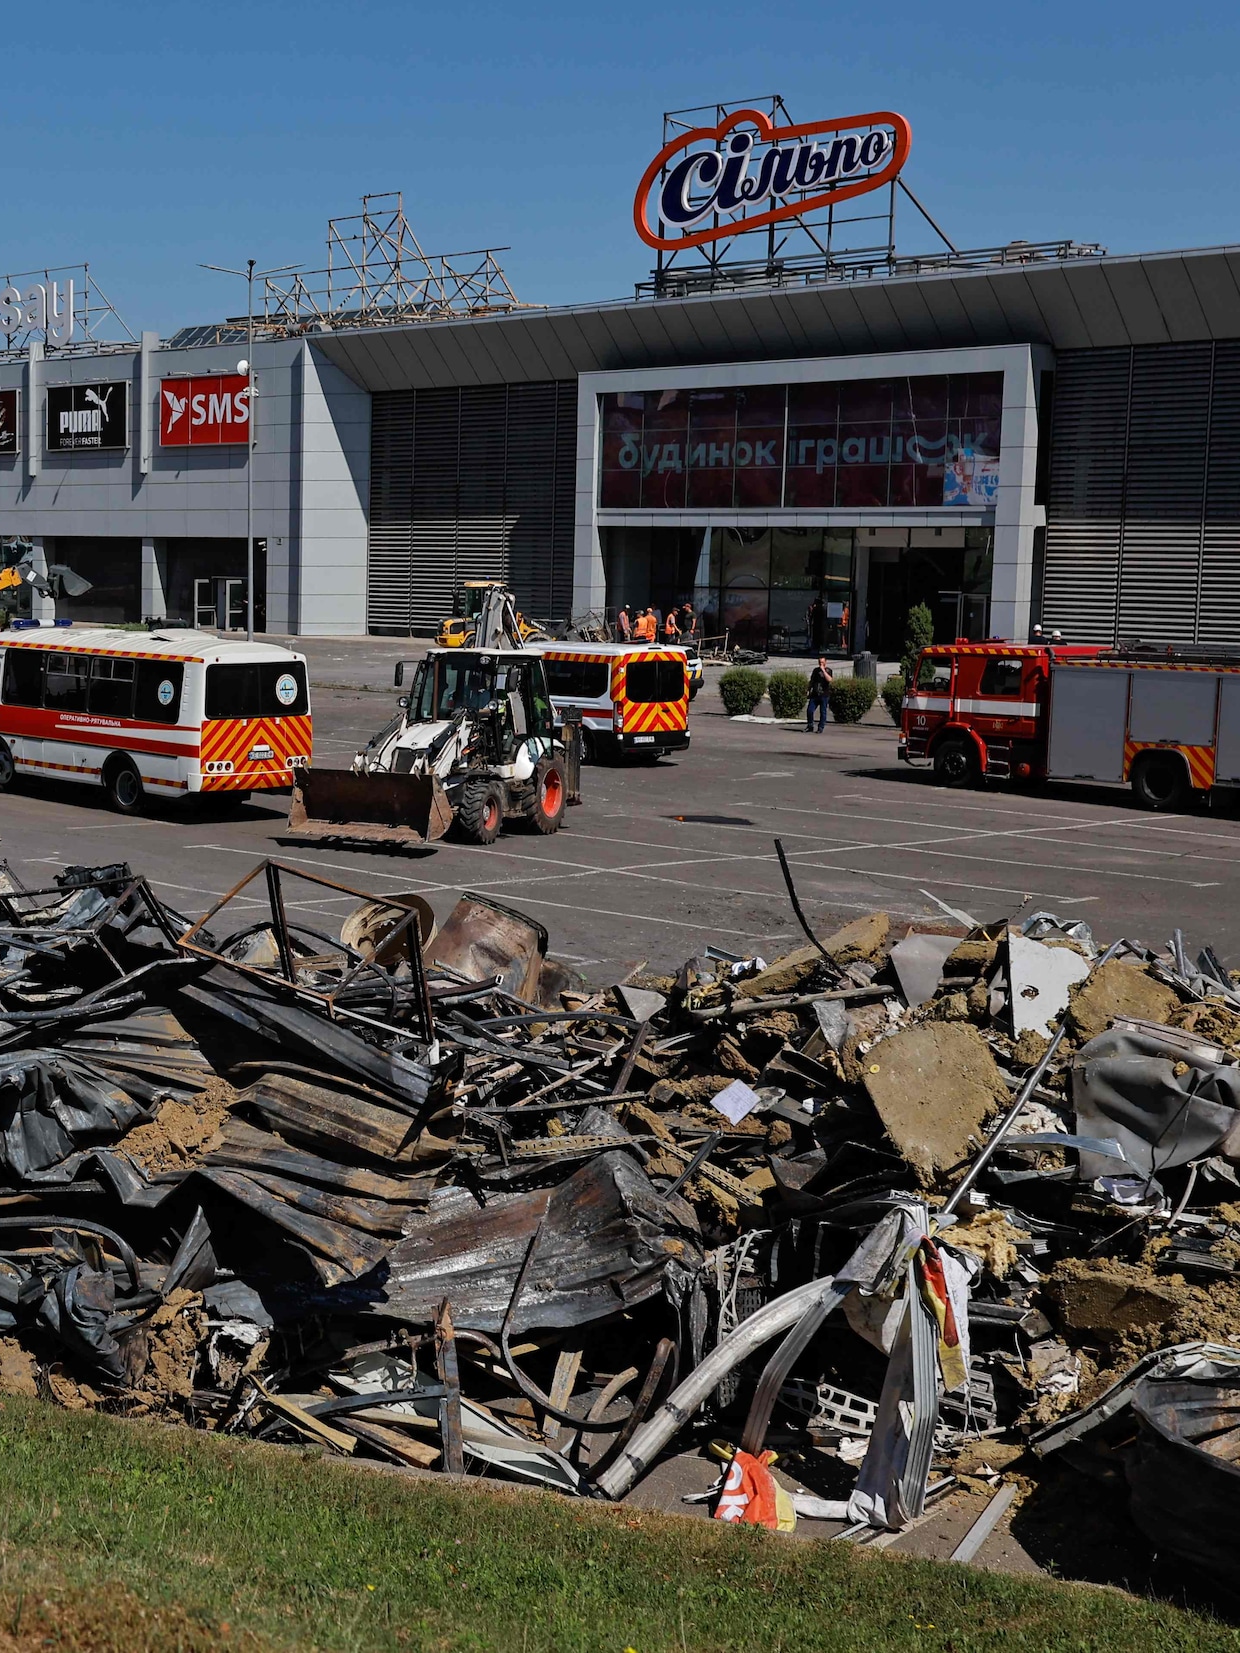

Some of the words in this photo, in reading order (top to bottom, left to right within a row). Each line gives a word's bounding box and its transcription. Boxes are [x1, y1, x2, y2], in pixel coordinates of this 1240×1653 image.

[659, 130, 892, 228] Сільпо
[60, 409, 102, 434] PUMA
[192, 391, 249, 425] SMS
[618, 432, 777, 478] будинок
[916, 715, 926, 726] 10
